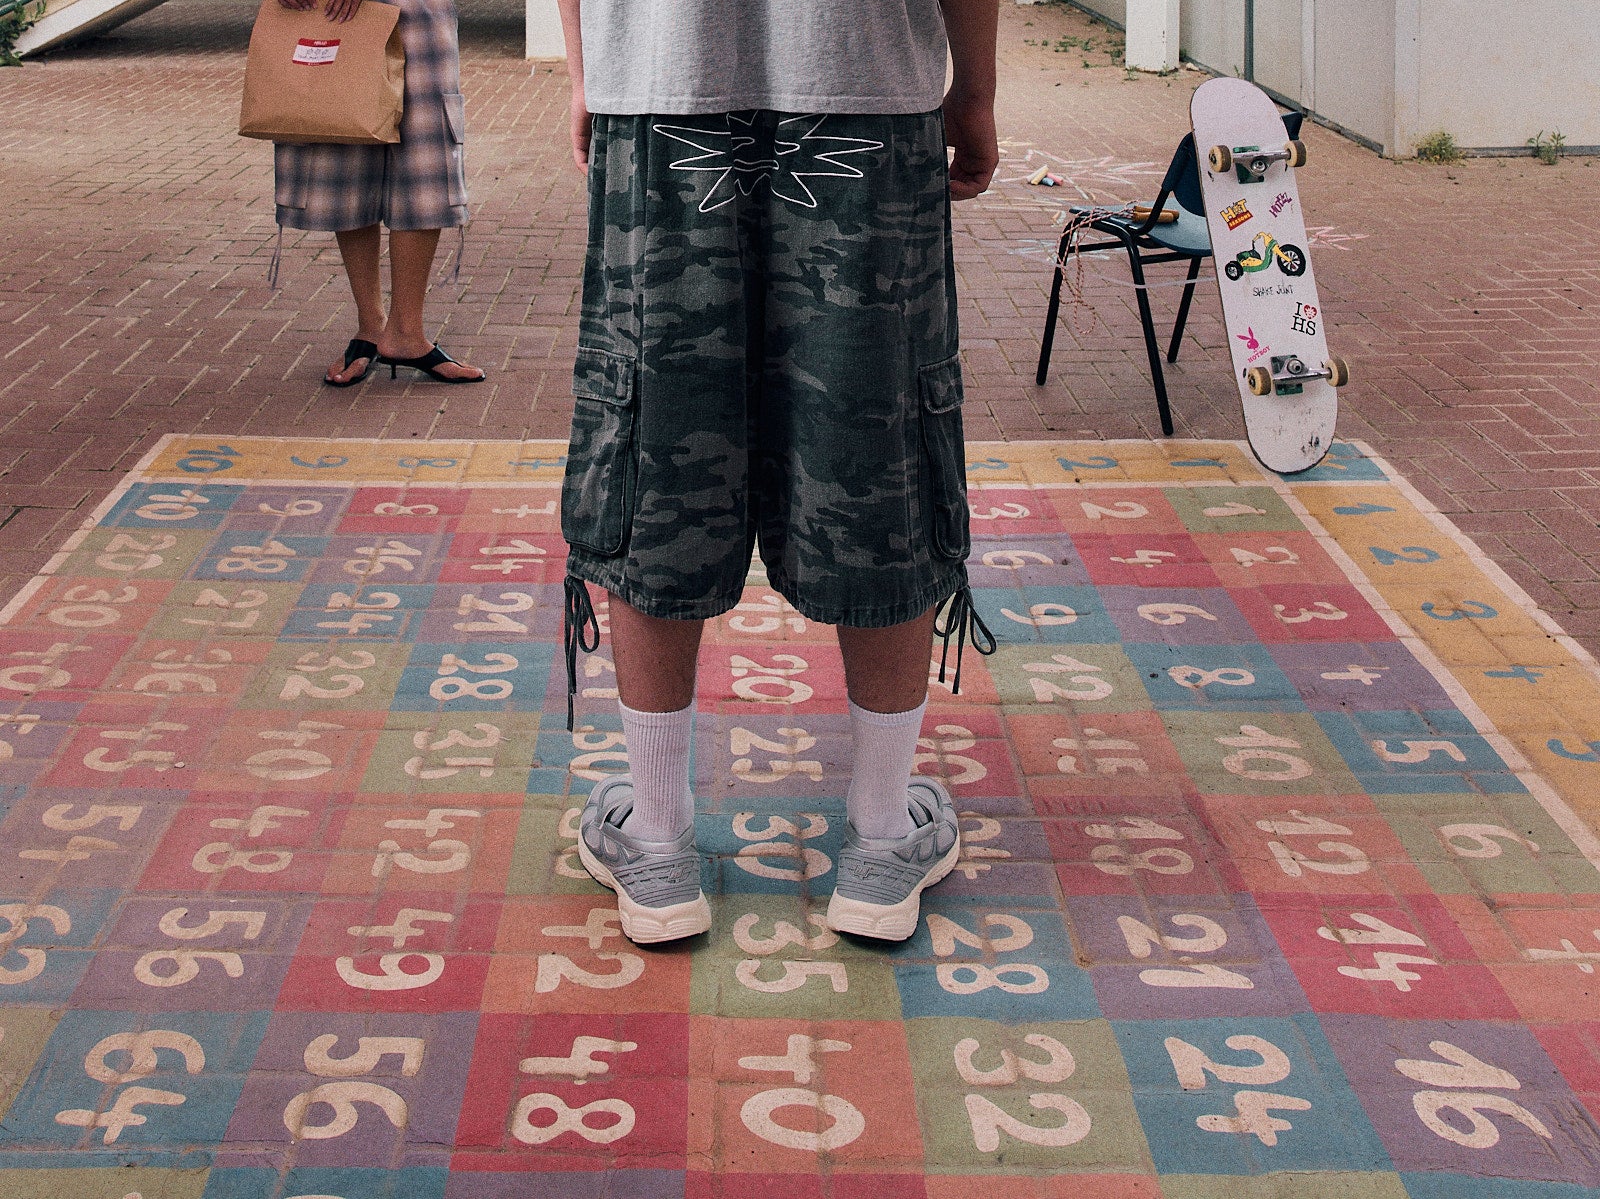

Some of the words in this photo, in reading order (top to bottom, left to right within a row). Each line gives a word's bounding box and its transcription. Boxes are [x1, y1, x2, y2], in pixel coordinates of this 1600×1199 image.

[1290, 315, 1317, 336] HS
[1294, 301, 1303, 317] I
[176, 445, 244, 473] 10
[291, 455, 349, 469] 9
[398, 458, 458, 468] 8
[508, 456, 567, 470] 7
[1056, 456, 1119, 471] 2
[1170, 458, 1228, 468] 1
[135, 489, 209, 521] 10
[258, 500, 323, 517] 9
[373, 502, 439, 516] 8
[492, 500, 557, 518] 7
[968, 503, 1030, 519] 3
[1081, 501, 1148, 519] 2
[1203, 502, 1267, 517] 1
[1332, 503, 1396, 515] 1
[95, 534, 176, 571] 20
[216, 540, 297, 573] 18
[343, 540, 422, 575] 16
[471, 539, 547, 574] 14
[982, 549, 1053, 569] 6
[1110, 549, 1176, 567] 4
[1230, 546, 1299, 568] 2
[1369, 546, 1441, 565] 2
[47, 585, 139, 628] 30
[181, 588, 268, 628] 27
[316, 591, 401, 634] 24
[453, 592, 534, 633] 21
[1000, 603, 1078, 626] 9
[1137, 603, 1217, 625] 6
[1273, 601, 1348, 623] 3
[1421, 600, 1499, 621] 3
[0, 642, 93, 692] 40
[133, 648, 232, 696] 36
[279, 650, 376, 699] 32
[429, 653, 519, 700] 28
[730, 654, 814, 704] 20
[1022, 654, 1114, 702] 12
[1167, 665, 1256, 689] 8
[1321, 664, 1390, 686] 4
[1483, 664, 1553, 684] 4
[83, 721, 189, 772] 45
[246, 720, 345, 780] 40
[403, 723, 501, 779] 35
[730, 727, 824, 783] 25
[1214, 725, 1313, 781] 10
[1372, 739, 1466, 763] 5
[19, 803, 143, 862] 54
[192, 805, 310, 873] 48
[372, 809, 481, 877] 42
[732, 812, 833, 883] 30
[1085, 816, 1194, 875] 18
[1256, 809, 1372, 877] 12
[1440, 823, 1540, 858] 6
[134, 907, 266, 987] 56
[335, 908, 454, 991] 49
[534, 908, 645, 993] 42
[733, 912, 849, 993] 35
[926, 913, 1049, 994] 28
[1116, 914, 1254, 989] 21
[1317, 913, 1438, 991] 14
[55, 1030, 206, 1145] 64
[284, 1034, 426, 1139] 56
[511, 1036, 638, 1144] 48
[738, 1033, 865, 1151] 40
[954, 1034, 1091, 1152] 32
[1165, 1035, 1312, 1147] 24
[1394, 1041, 1552, 1149] 16
